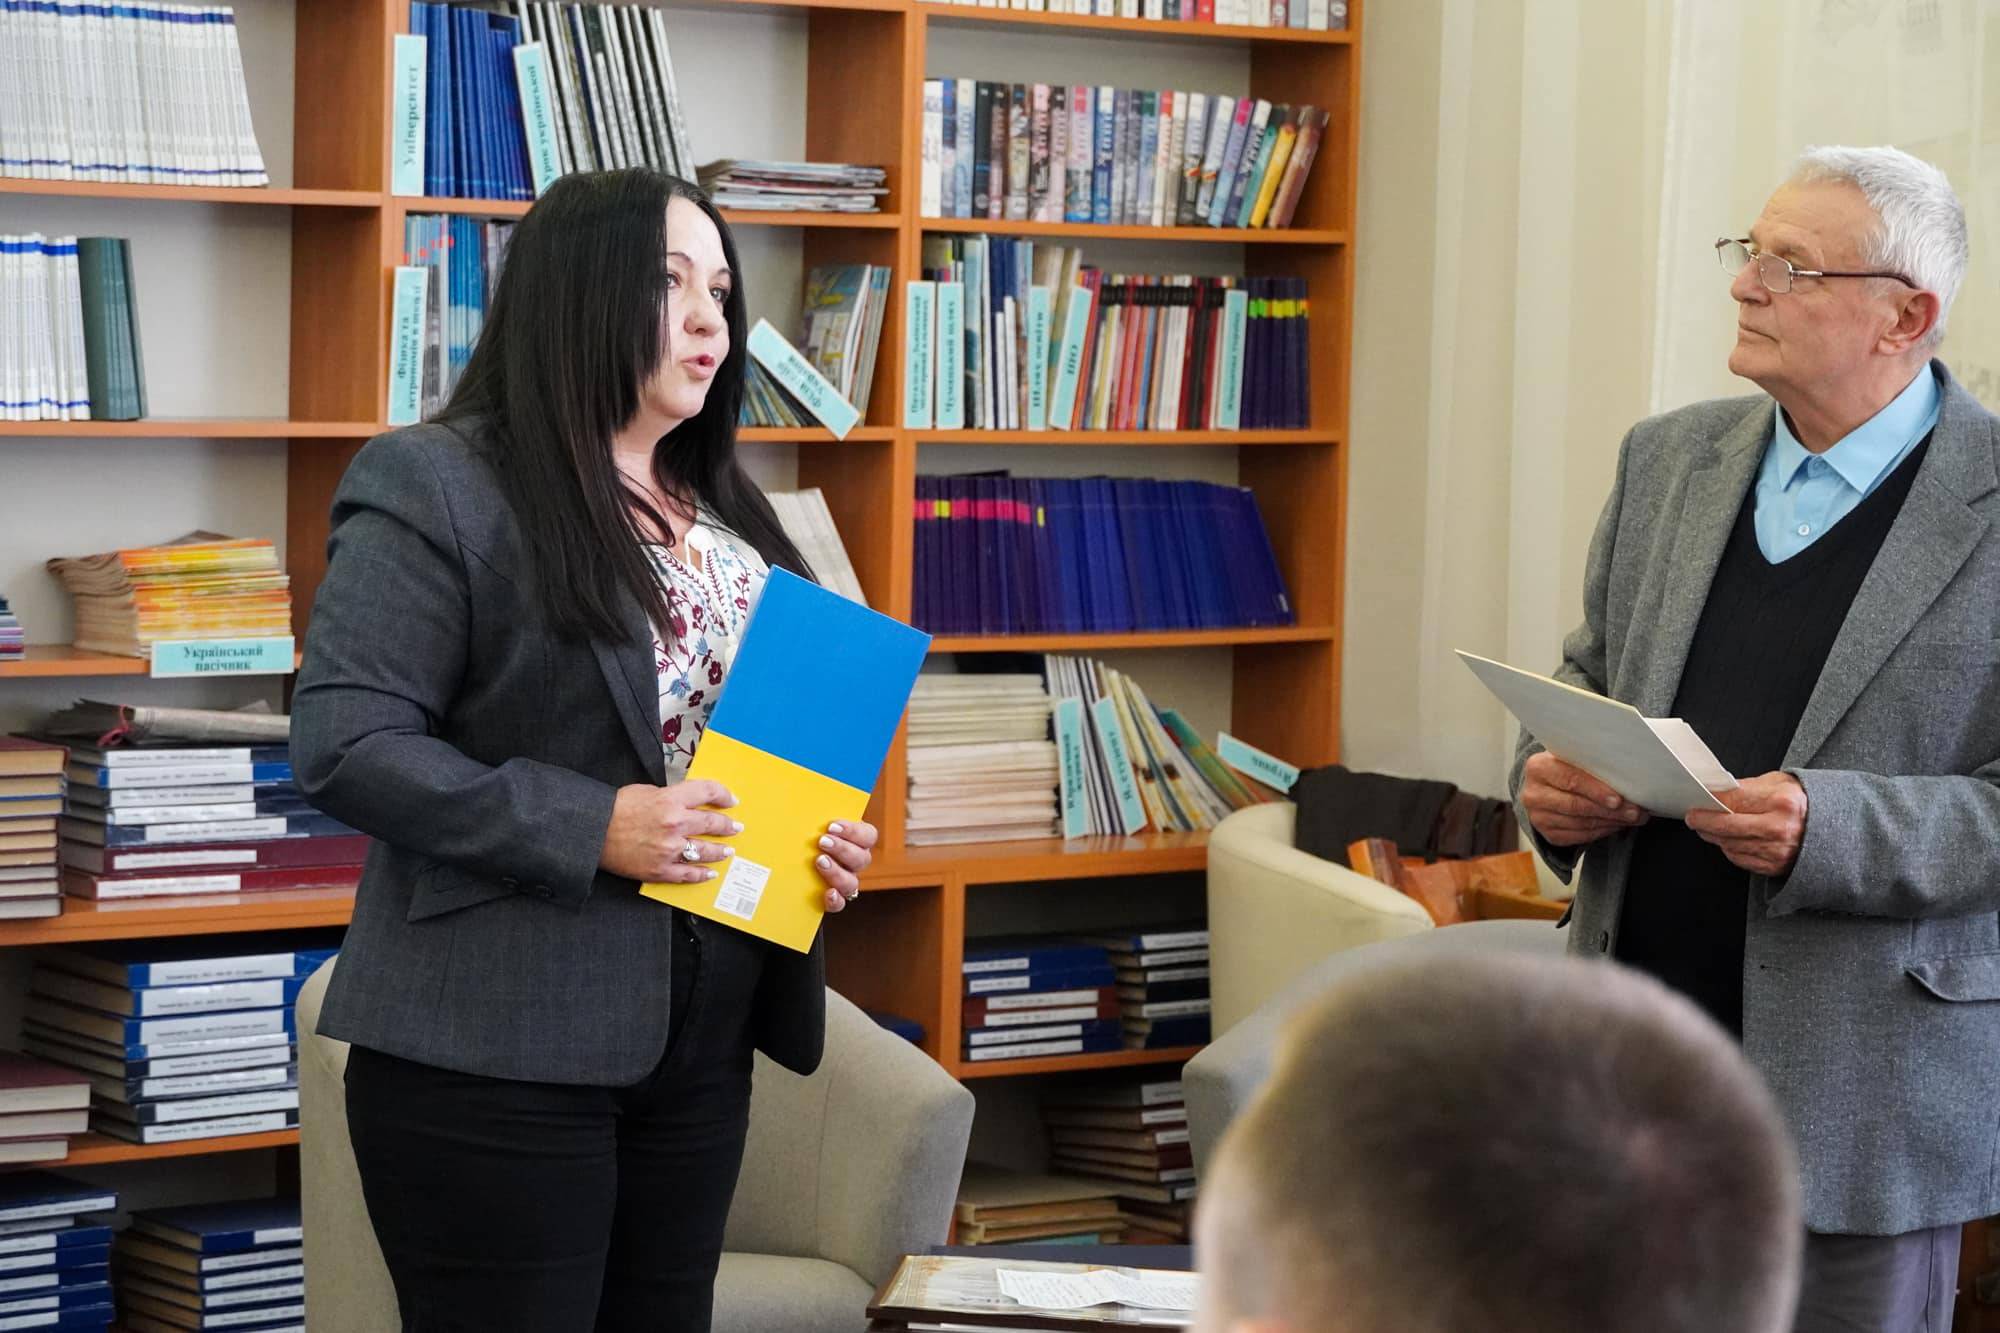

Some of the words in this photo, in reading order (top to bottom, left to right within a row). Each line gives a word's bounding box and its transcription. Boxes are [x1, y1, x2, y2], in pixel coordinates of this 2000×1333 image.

[525, 63, 549, 145] української
[539, 146, 553, 182] Урок
[184, 645, 263, 660] Український
[195, 659, 252, 672] пасічник
